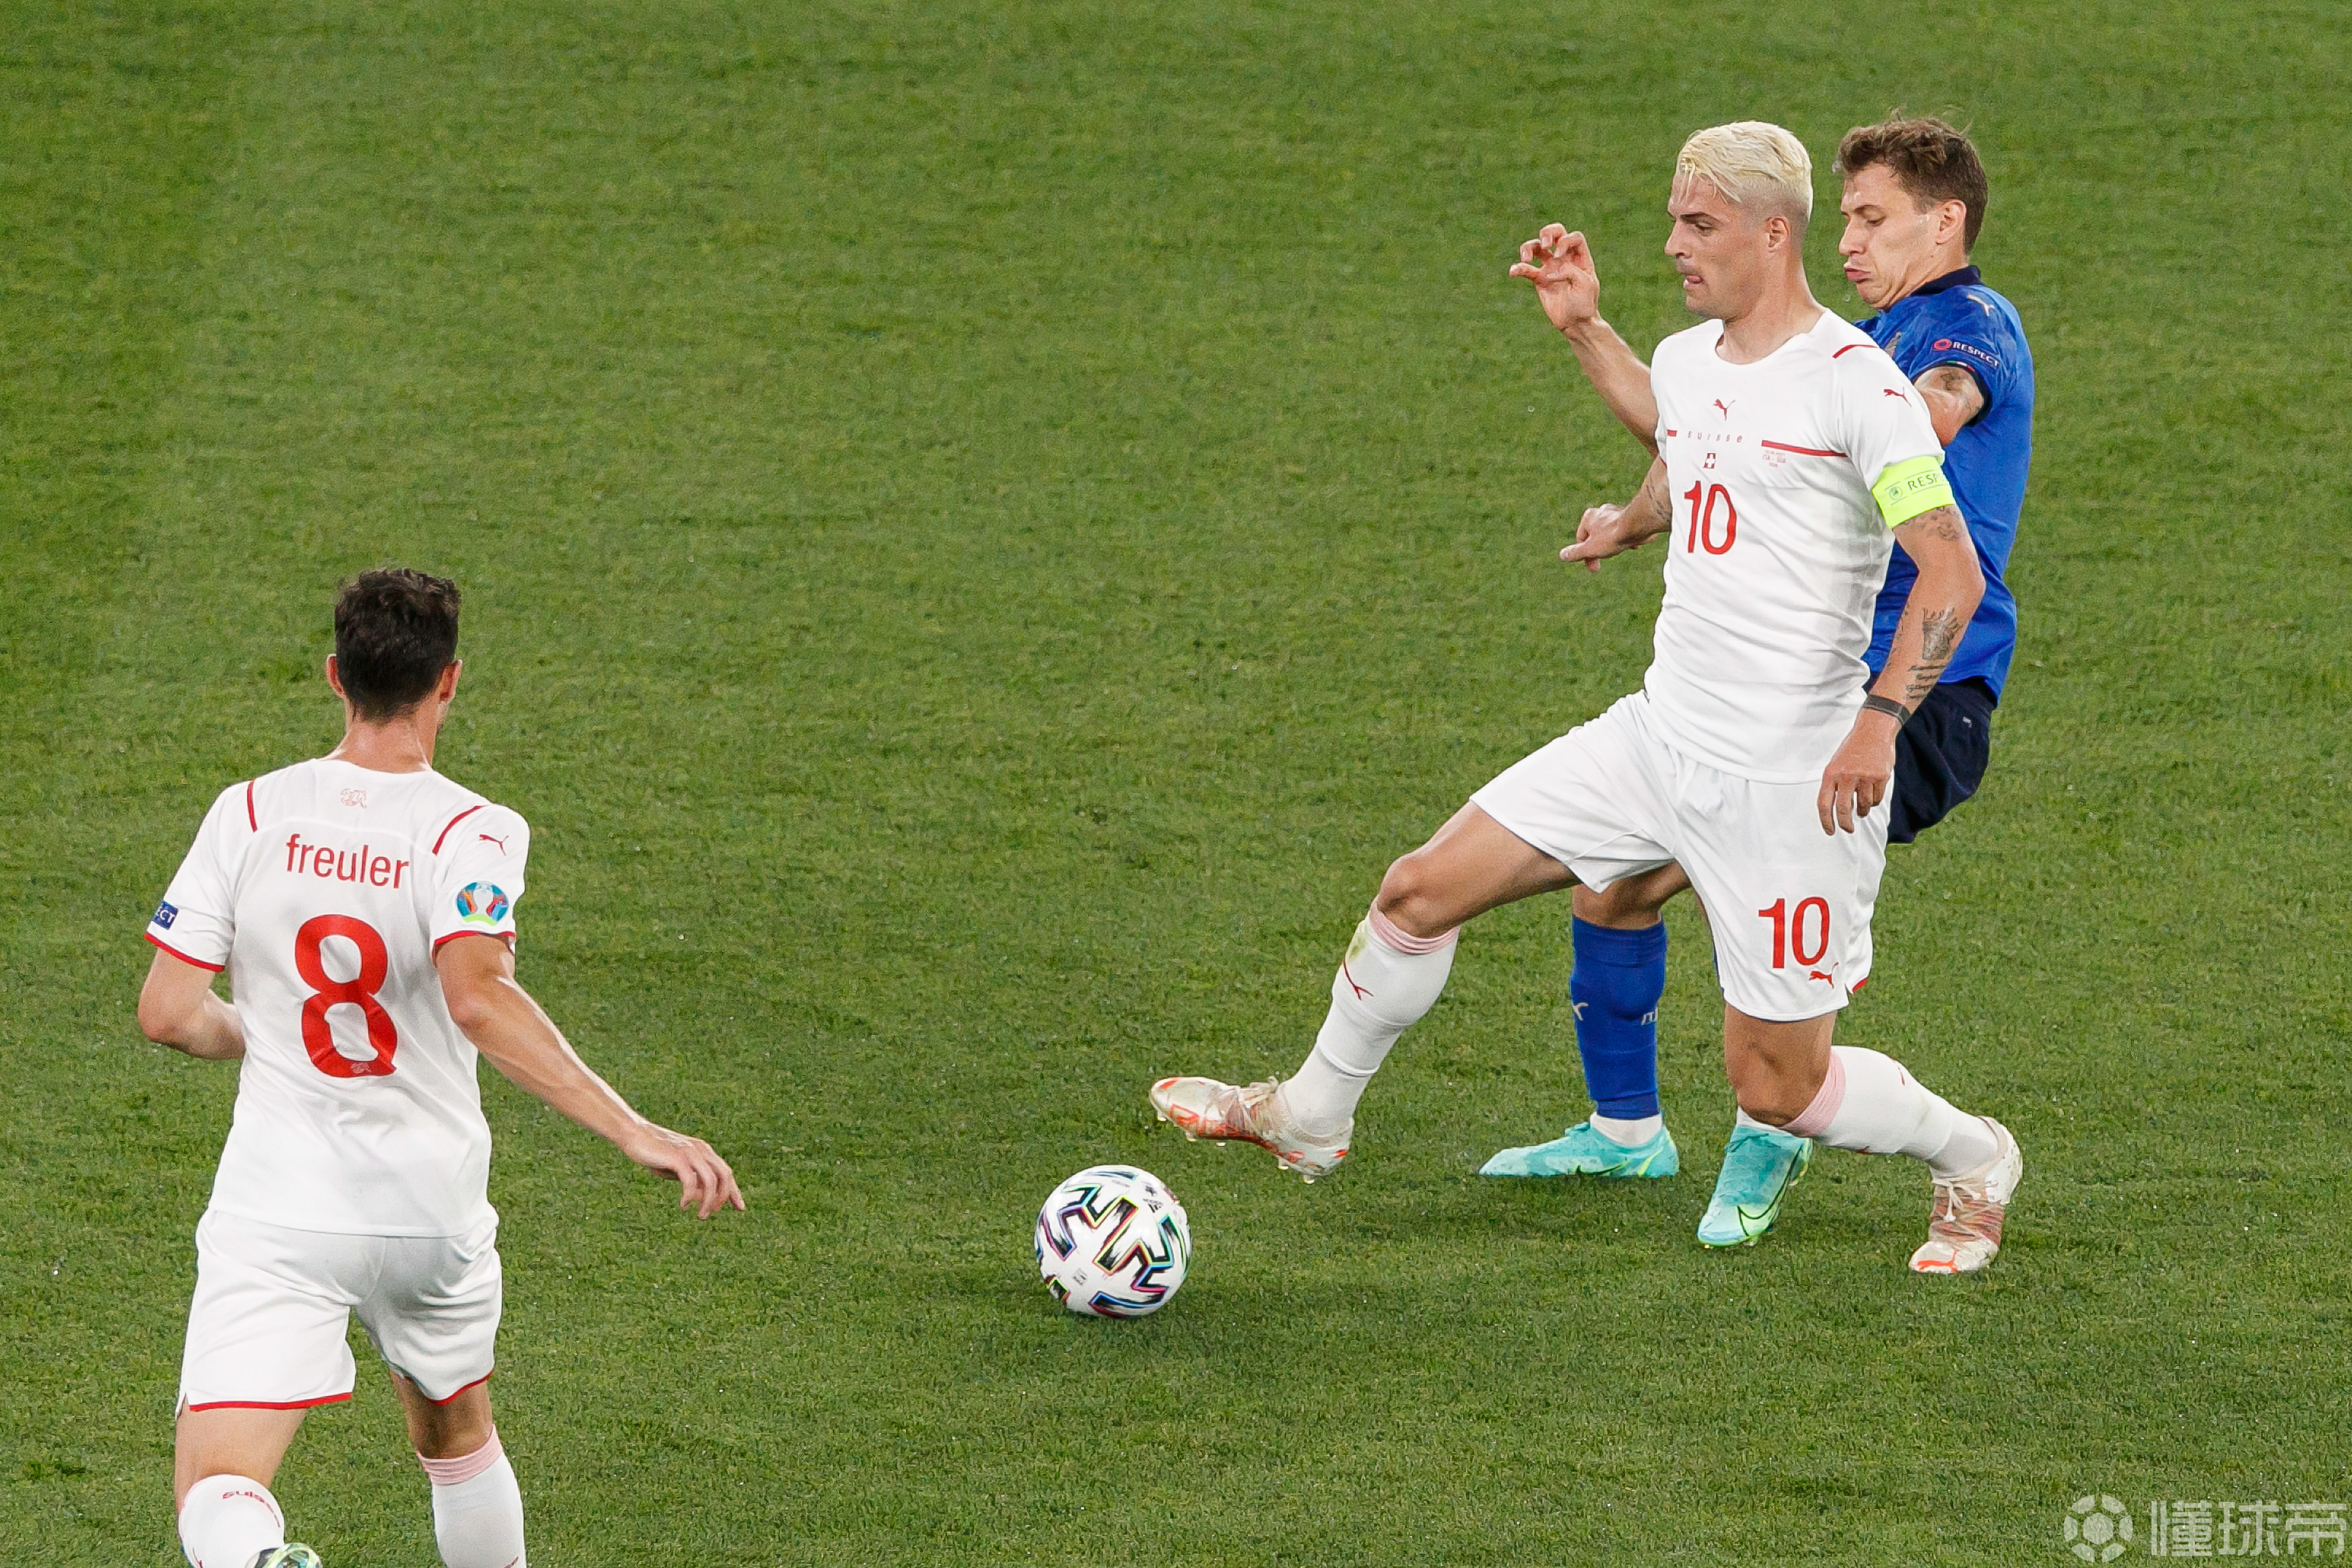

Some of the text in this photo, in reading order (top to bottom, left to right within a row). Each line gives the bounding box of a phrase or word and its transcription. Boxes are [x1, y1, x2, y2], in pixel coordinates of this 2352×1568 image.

[1953, 342, 2000, 366] RESPECT
[1684, 481, 1737, 554] 10
[286, 834, 411, 889] freuler
[1758, 897, 1830, 969] 10
[295, 914, 397, 1079] 8
